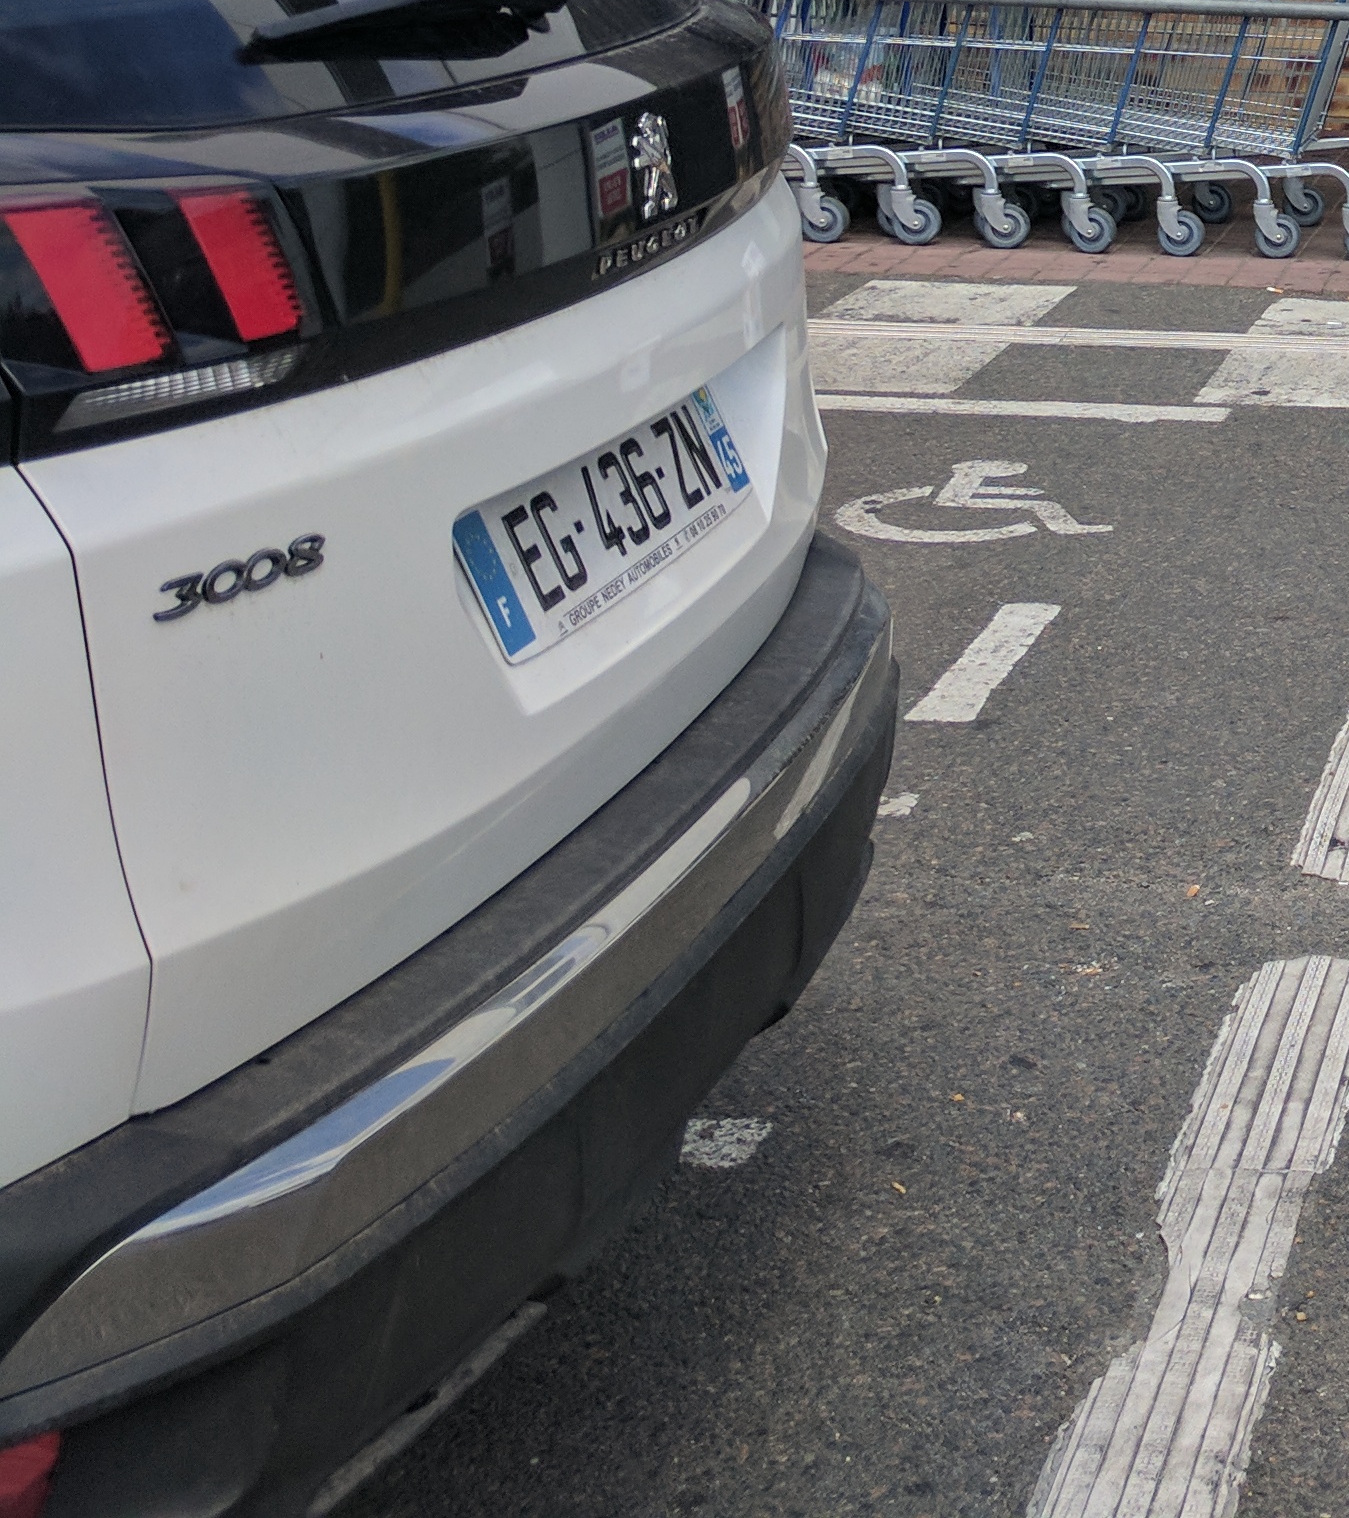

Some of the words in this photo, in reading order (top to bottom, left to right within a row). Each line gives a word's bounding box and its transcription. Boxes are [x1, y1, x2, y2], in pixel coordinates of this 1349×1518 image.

[599, 217, 700, 276] PEUGEOT
[716, 435, 743, 479] 45
[152, 533, 326, 622] 3008
[569, 597, 602, 626] GROUPE
[601, 579, 627, 604] NEDEY
[627, 543, 673, 585] AUTOMOBILES
[497, 595, 512, 629] F
